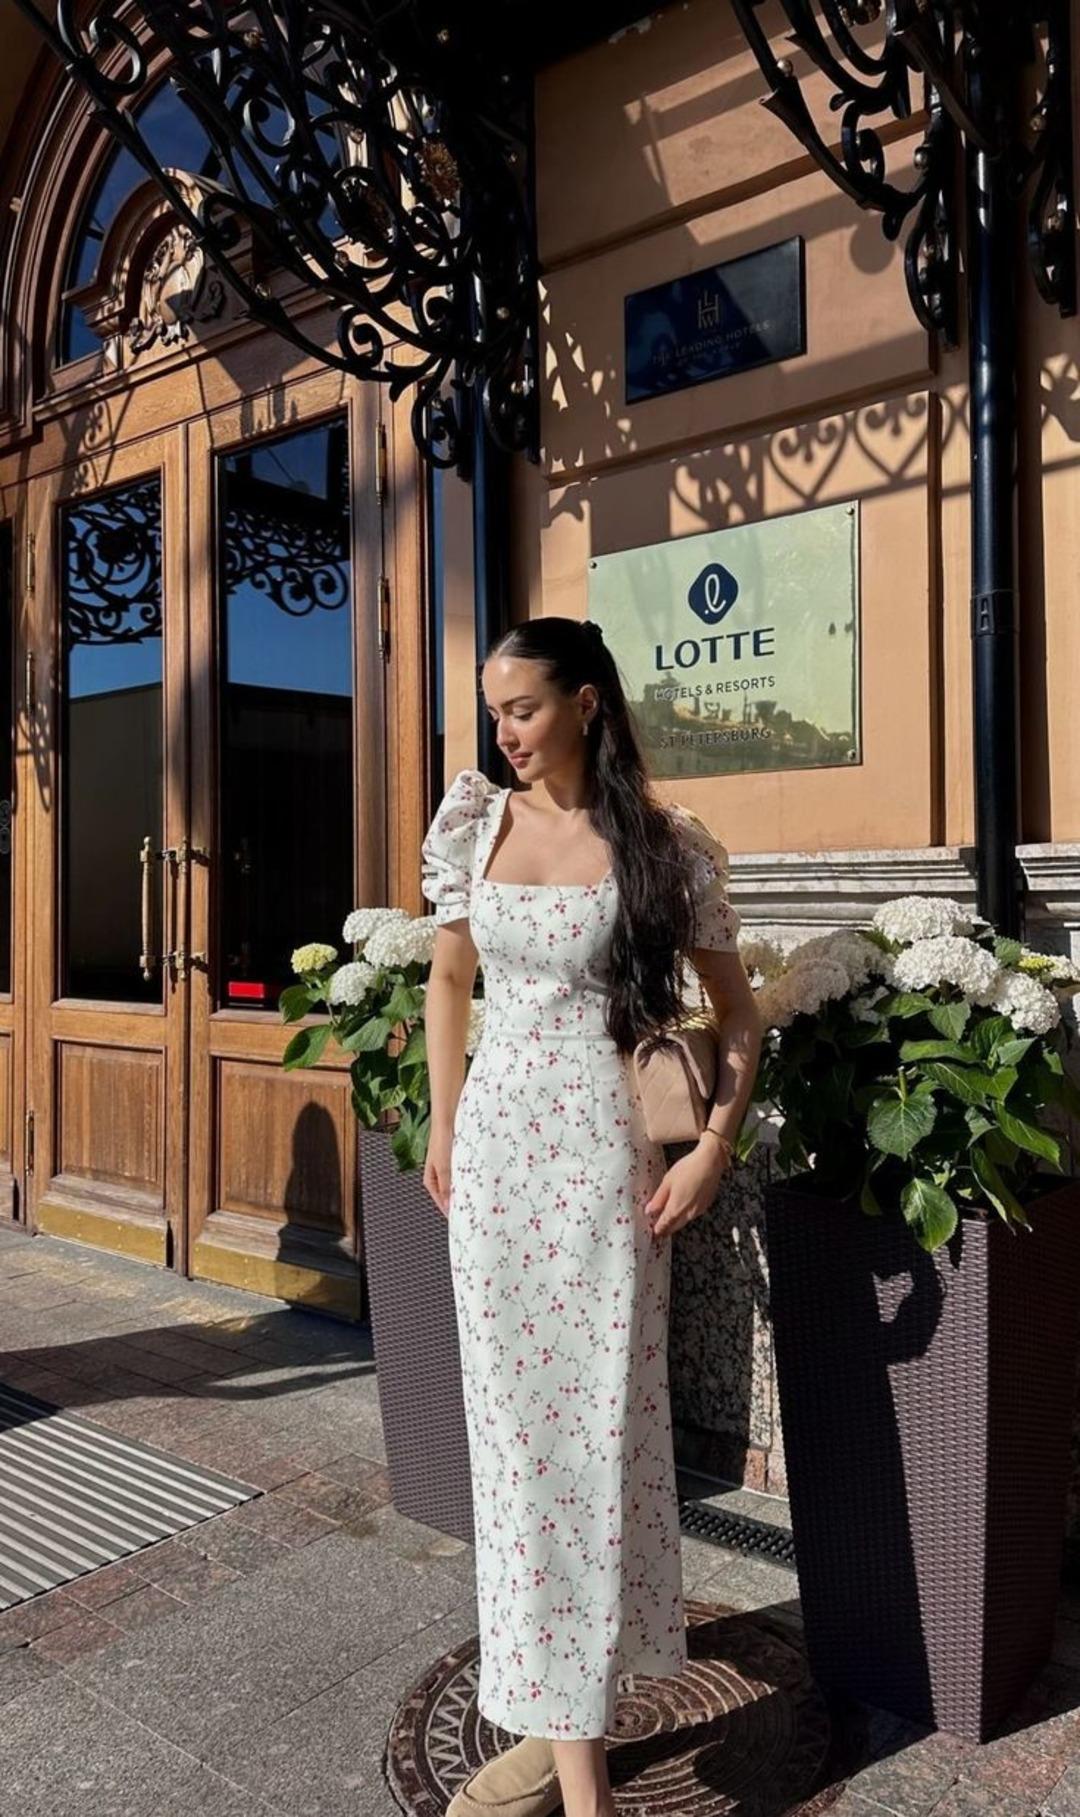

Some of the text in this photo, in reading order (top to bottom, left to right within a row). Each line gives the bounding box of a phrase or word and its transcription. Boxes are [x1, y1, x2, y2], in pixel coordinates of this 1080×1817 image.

[675, 336, 722, 357] LEADING
[726, 320, 770, 342] HOTELS
[656, 627, 775, 671] LOTTE
[656, 676, 776, 701] HOTELS & RESORTS
[681, 727, 771, 747] PETERSBURG
